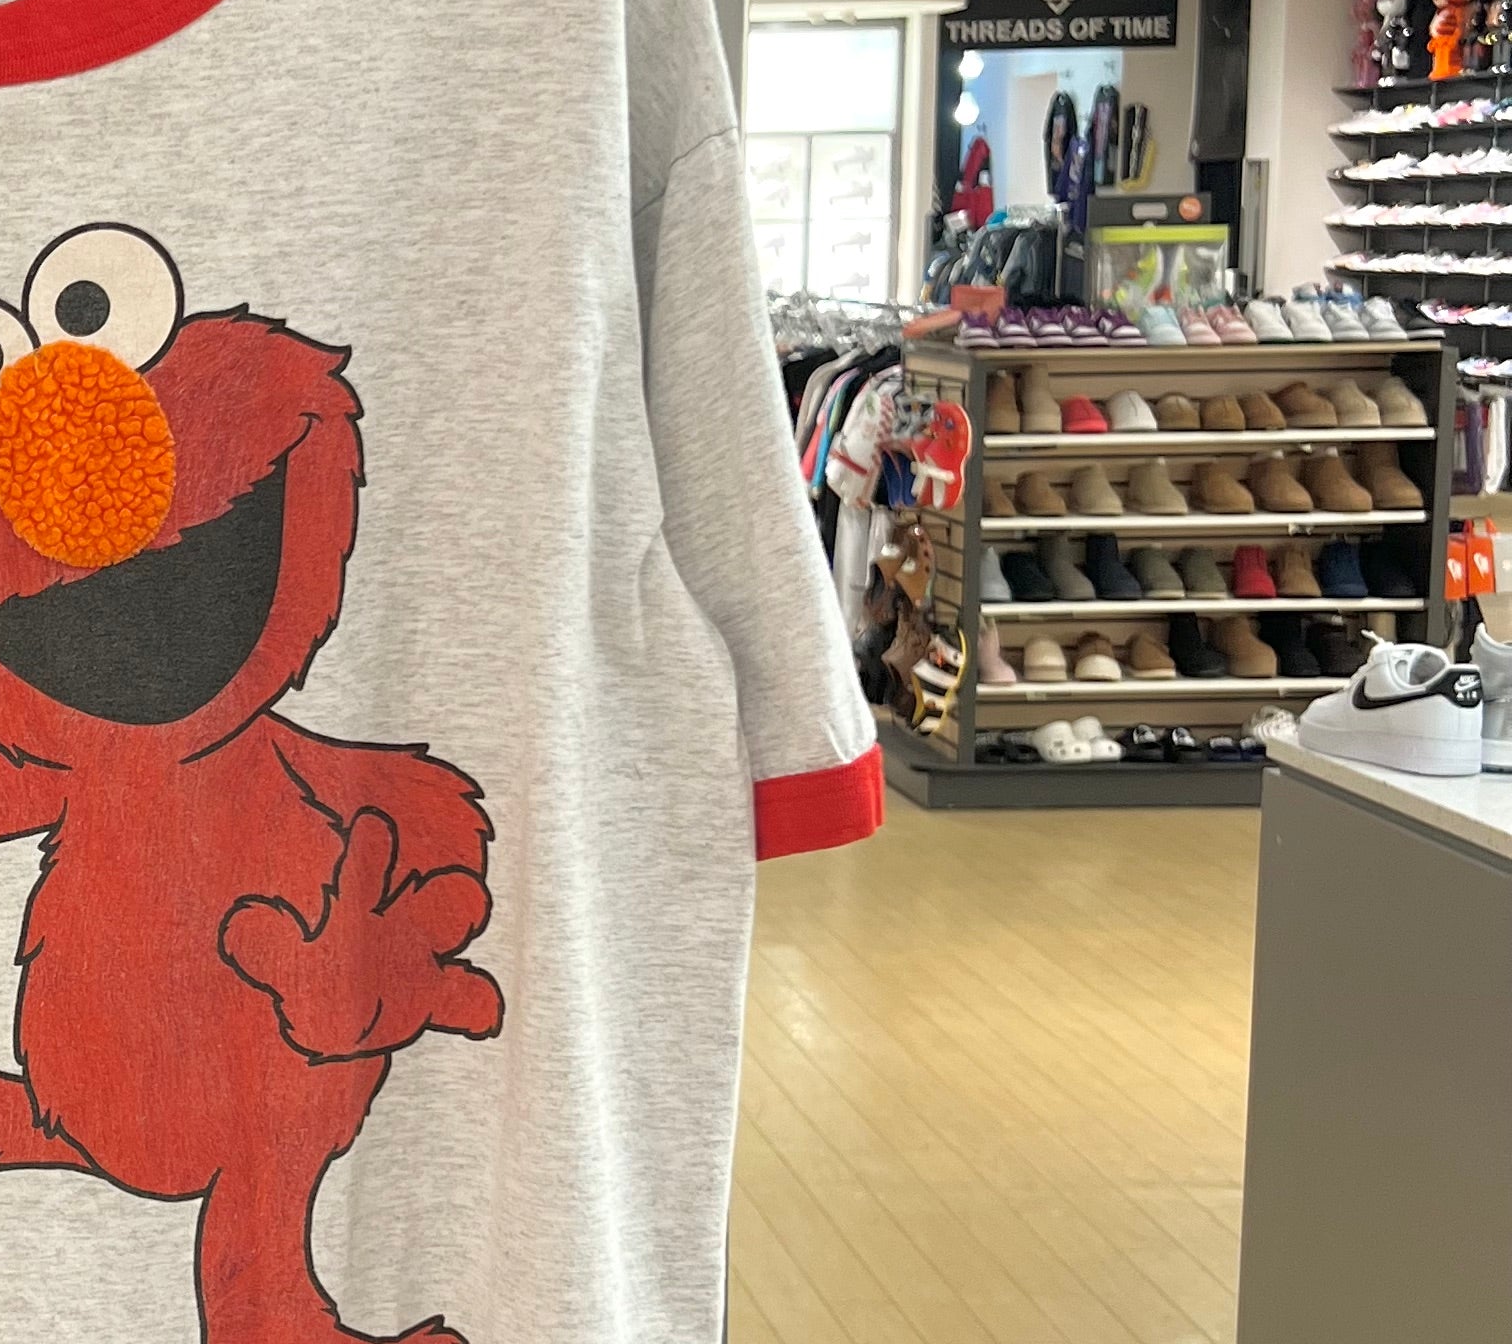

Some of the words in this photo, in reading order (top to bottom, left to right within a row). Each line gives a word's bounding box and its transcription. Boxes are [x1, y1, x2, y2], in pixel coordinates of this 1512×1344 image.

[945, 17, 1065, 43] THREADS
[1069, 16, 1107, 41] OF
[1109, 15, 1171, 40] TIME
